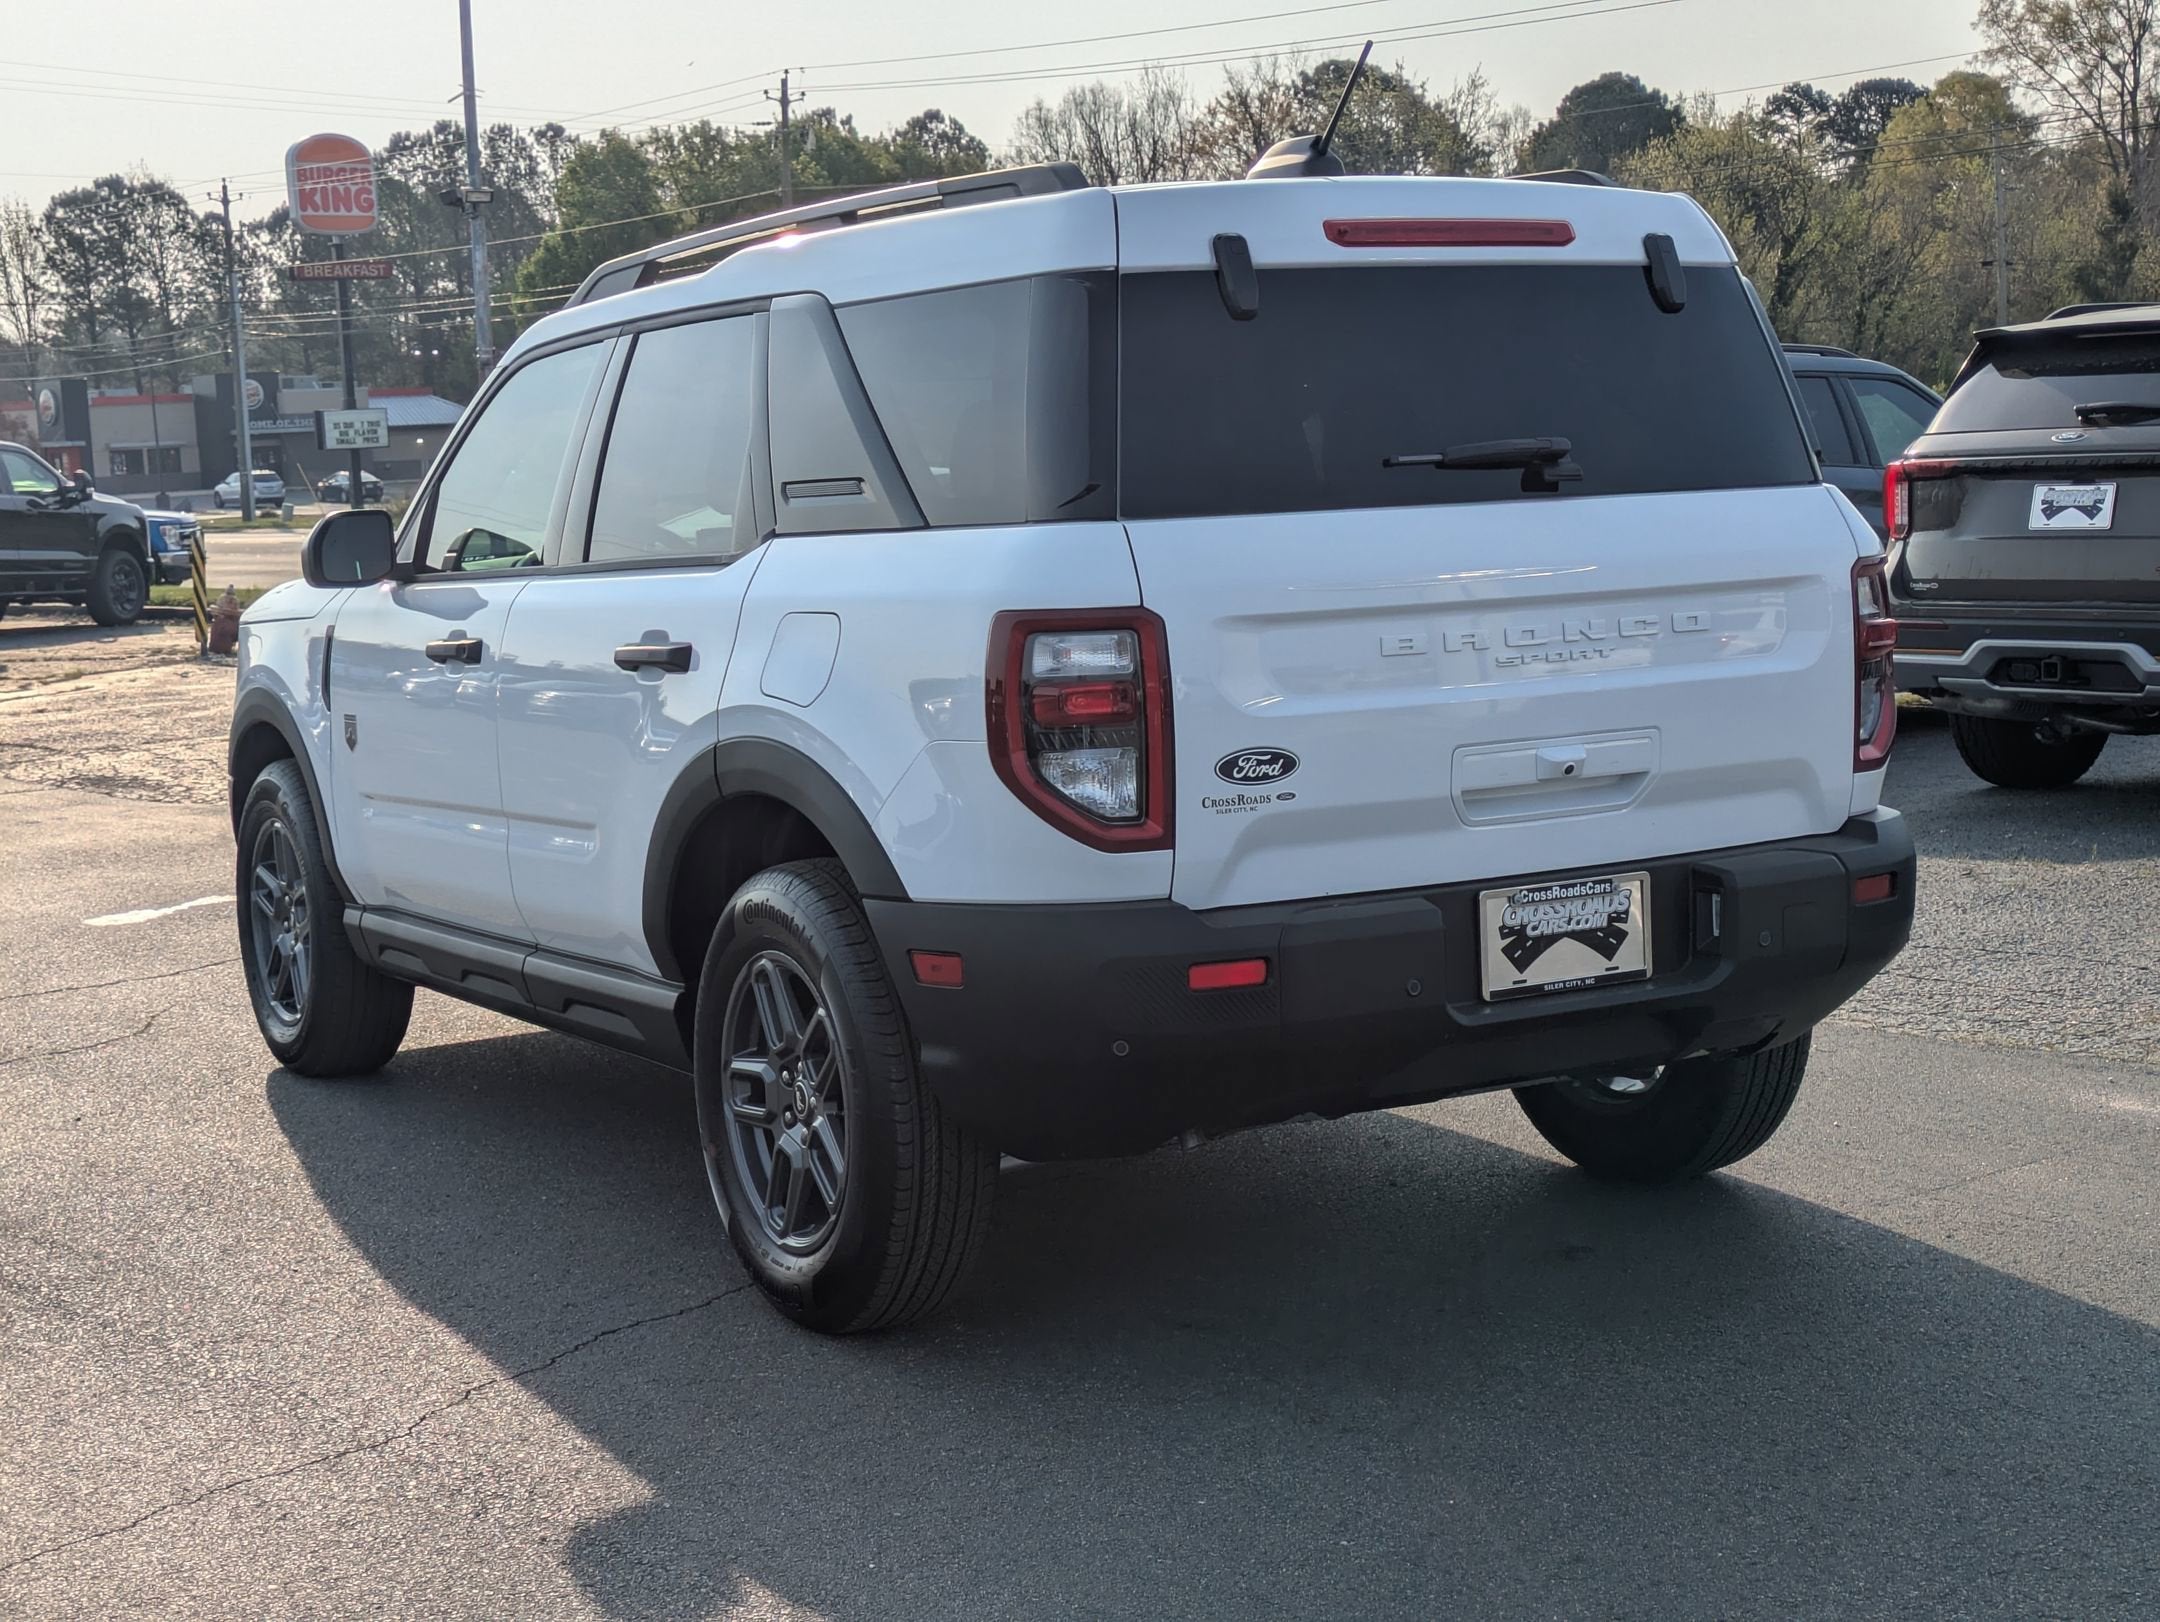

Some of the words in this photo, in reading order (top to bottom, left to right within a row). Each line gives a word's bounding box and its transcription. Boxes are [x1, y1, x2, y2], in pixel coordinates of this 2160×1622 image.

[296, 166, 374, 187] BURGER
[300, 185, 375, 213] KING
[304, 263, 385, 277] BREAKFAST
[1380, 611, 1711, 657] BRONCO
[1496, 647, 1616, 668] SPORT
[1233, 755, 1284, 778] Ford
[1521, 881, 1611, 903] CrossRoadsCars
[1502, 888, 1633, 928] CROSSROADS
[743, 897, 806, 944] Continental
[1526, 911, 1608, 938] CARS.COM
[1543, 983, 1565, 991] SILER
[1566, 980, 1585, 989] CITY,
[1586, 977, 1596, 985] NC
